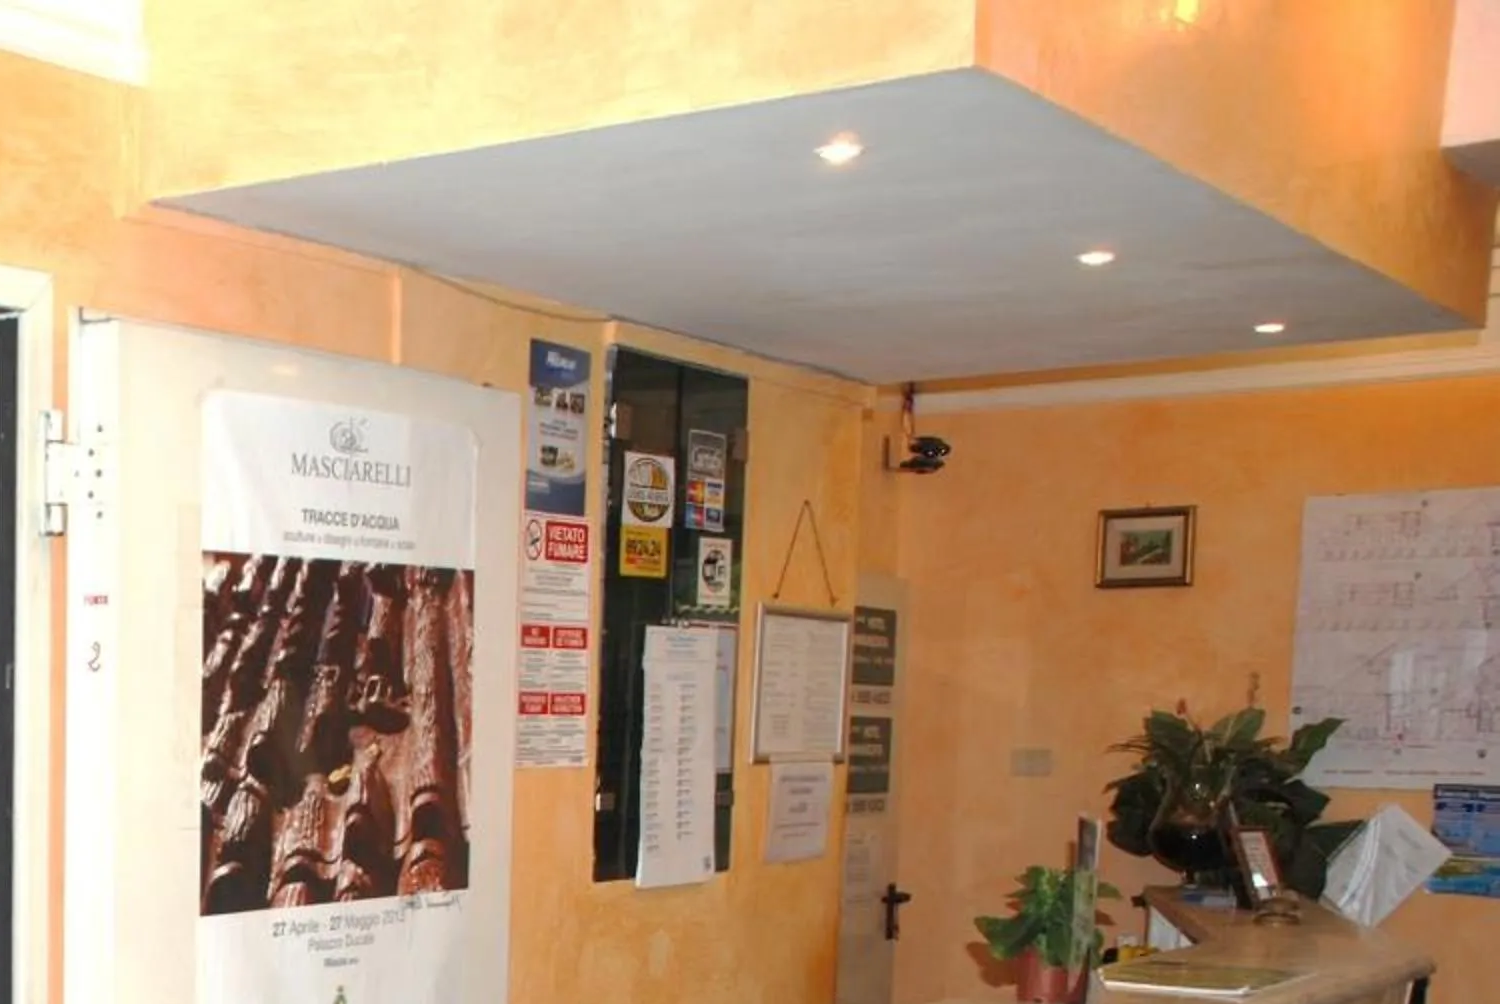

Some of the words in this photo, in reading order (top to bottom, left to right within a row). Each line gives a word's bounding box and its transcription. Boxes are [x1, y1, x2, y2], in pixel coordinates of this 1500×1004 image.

[291, 452, 411, 488] MASCIARELLI
[300, 507, 348, 528] TRACCE
[350, 512, 400, 531] D'ACQUA
[548, 525, 585, 543] VIETATO
[273, 921, 287, 938] 27
[290, 919, 320, 937] Aprile
[329, 914, 342, 931] 27
[344, 912, 381, 931] Maggio
